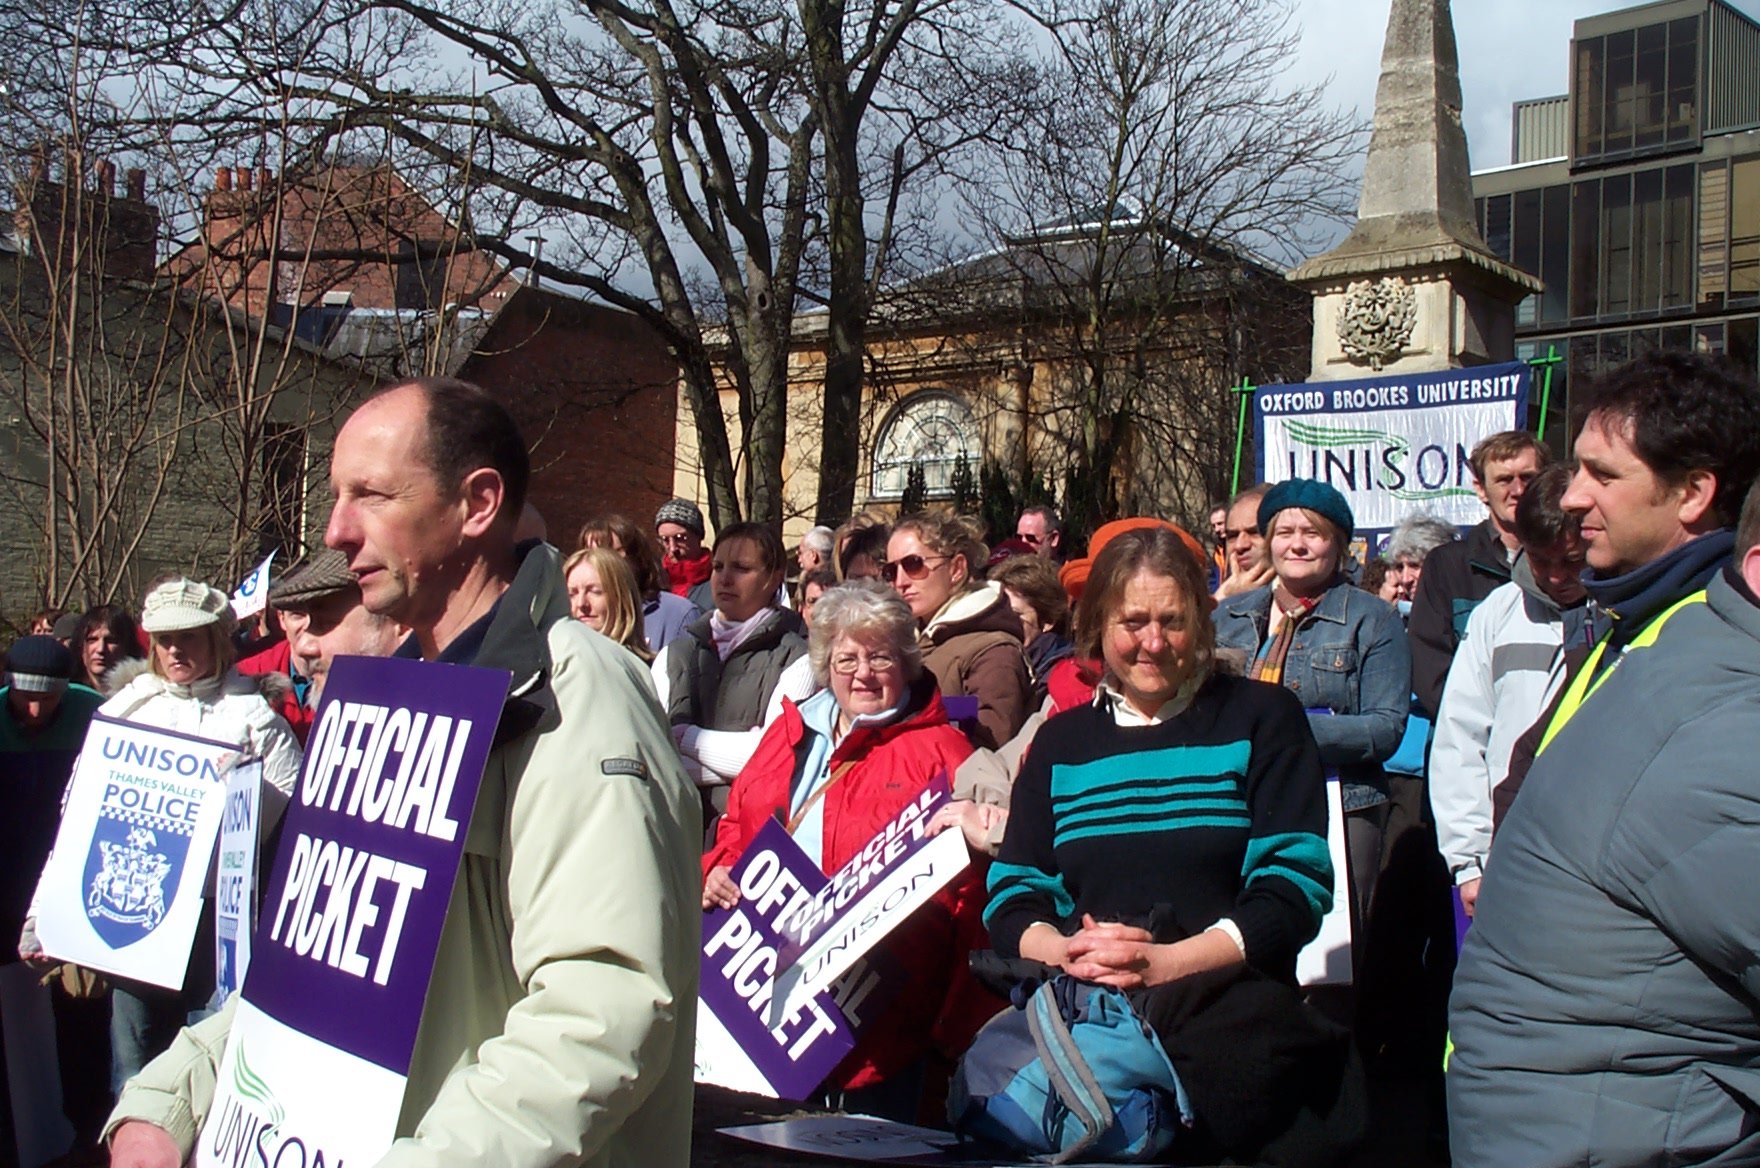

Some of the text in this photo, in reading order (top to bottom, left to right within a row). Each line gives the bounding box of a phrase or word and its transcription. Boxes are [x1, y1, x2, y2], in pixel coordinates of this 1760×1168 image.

[1260, 374, 1520, 412] OXFORD BROOKES UNIVERSITY
[102, 736, 220, 783] UNISON
[103, 783, 201, 823] POLICE
[109, 769, 206, 800] THAMES VALLEY
[301, 699, 473, 842] OFFICIAL
[270, 833, 428, 987] PICKET
[789, 788, 942, 934] OFFICIAL
[799, 809, 931, 947] PICKET
[803, 862, 934, 985] UNISON
